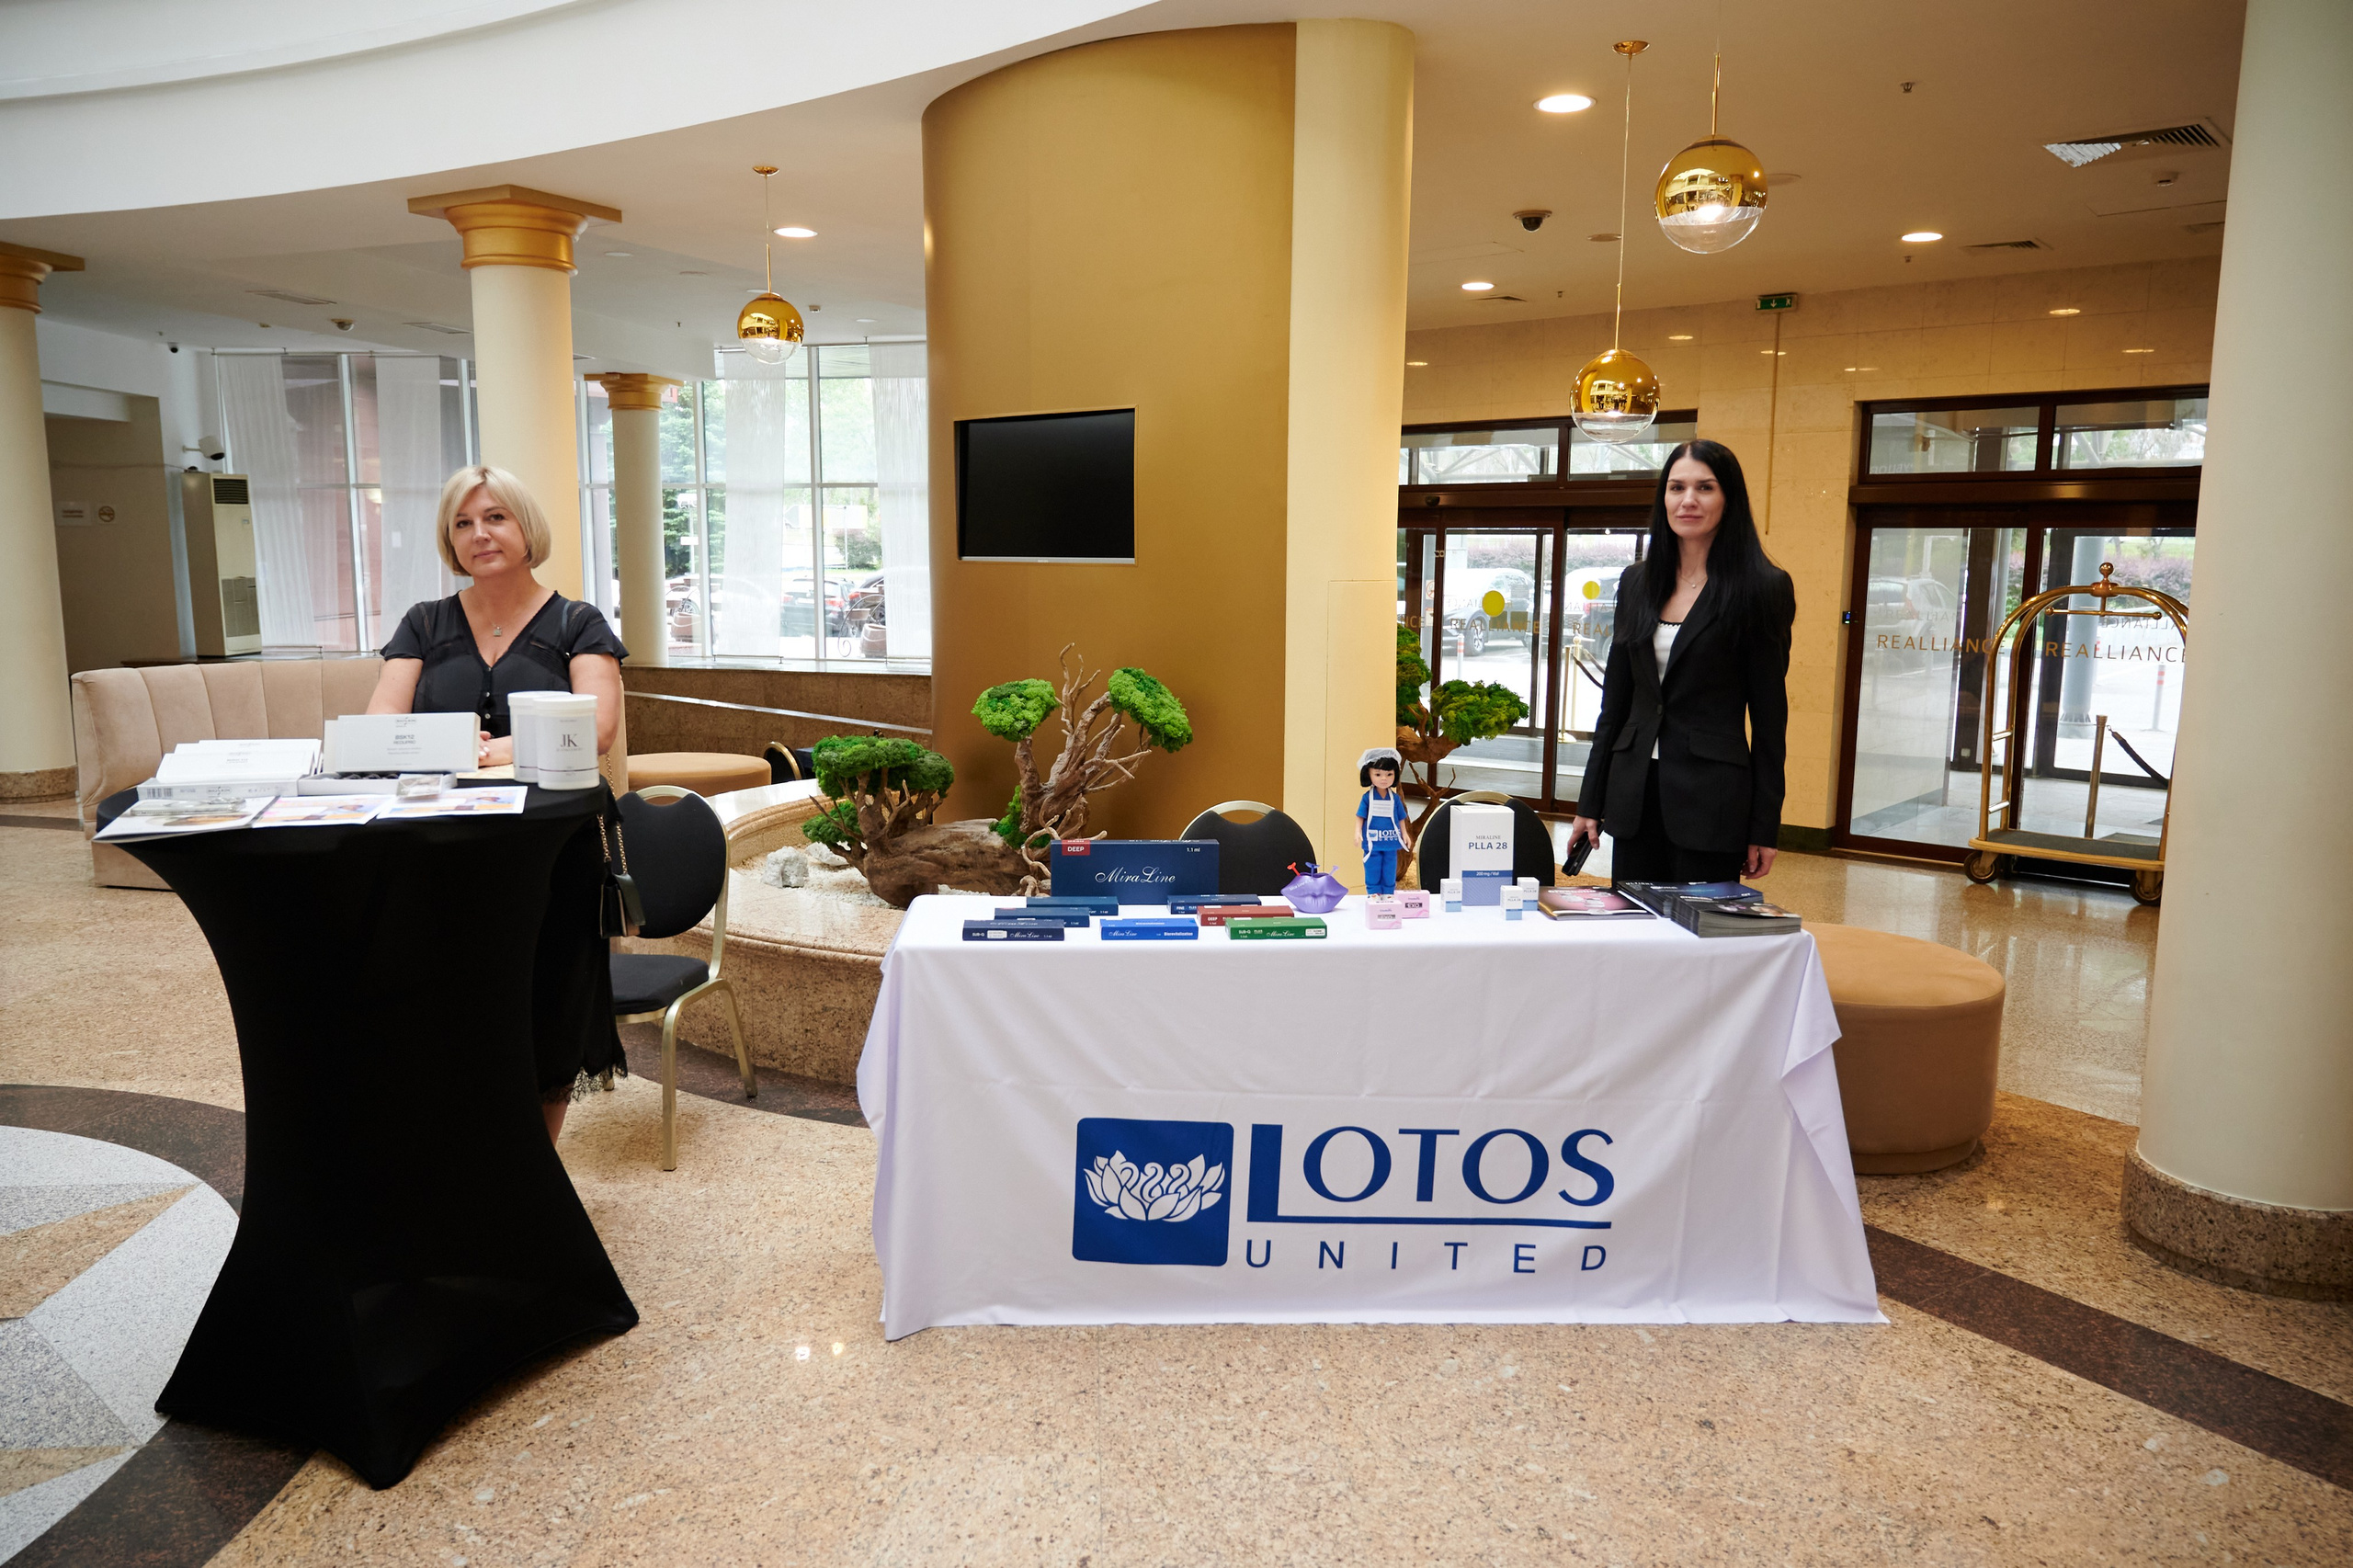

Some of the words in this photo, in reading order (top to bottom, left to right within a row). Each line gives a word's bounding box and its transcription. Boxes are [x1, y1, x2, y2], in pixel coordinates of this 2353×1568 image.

[1450, 618, 1540, 634] REALLIANCE
[560, 733, 578, 748] JK
[1468, 842, 1494, 850] PLLA
[1495, 842, 1508, 850] 28
[1246, 1123, 1616, 1224] LOTOS
[1245, 1239, 1608, 1274] UNITED
